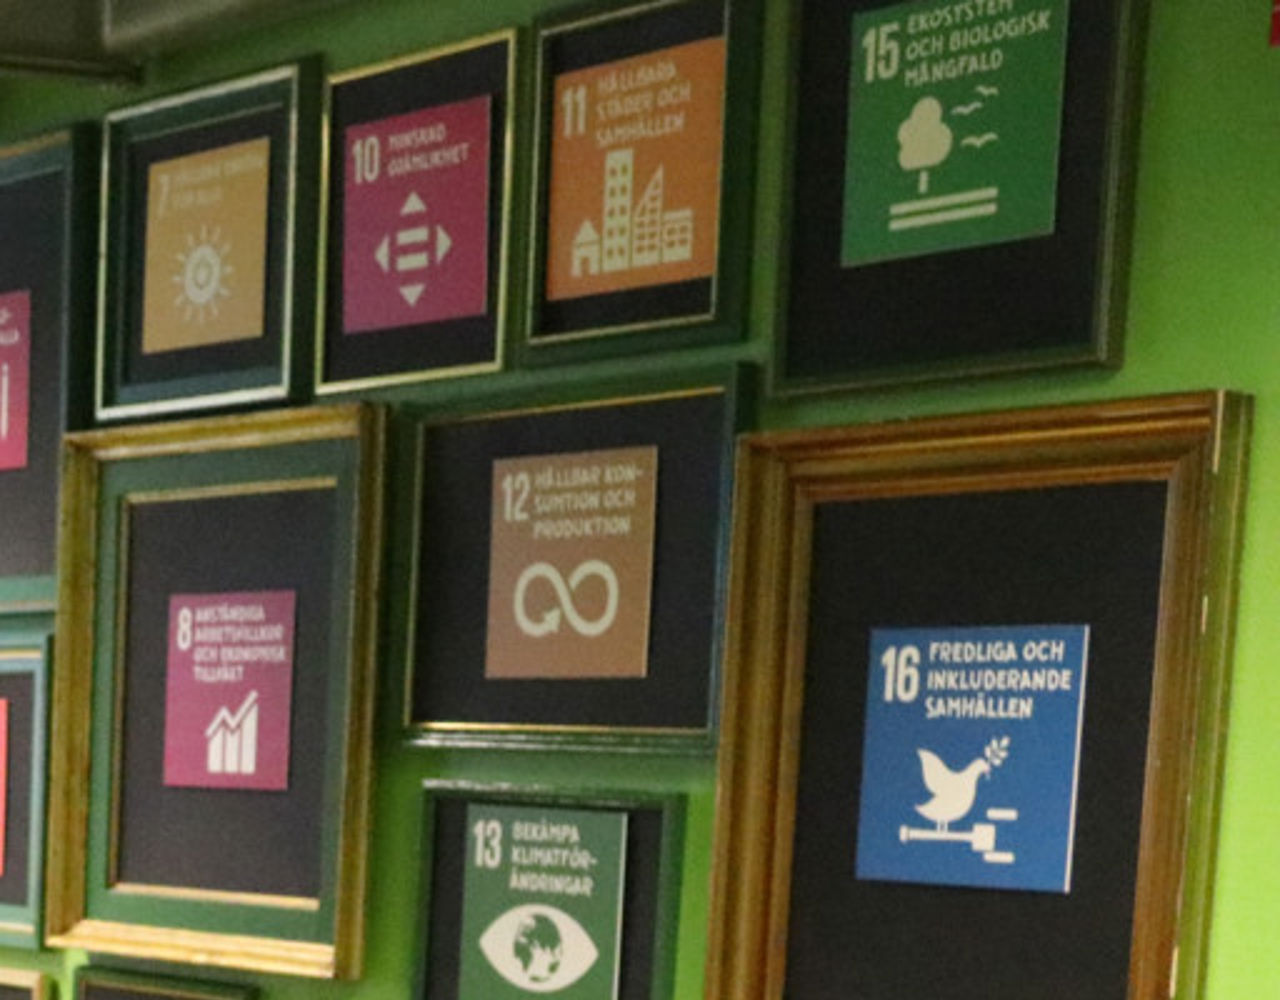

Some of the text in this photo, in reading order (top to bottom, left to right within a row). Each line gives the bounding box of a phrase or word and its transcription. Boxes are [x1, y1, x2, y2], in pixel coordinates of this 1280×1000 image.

[862, 22, 900, 83] 15
[906, 10, 1051, 60] OCH BIOLOGISK
[904, 49, 1003, 86] MÅNGFALD
[562, 84, 587, 140] 11
[353, 136, 380, 183] 10
[502, 472, 530, 522] 12
[603, 488, 636, 508] OCH
[534, 515, 631, 540] PRODUKTION
[178, 606, 192, 651] 8
[929, 639, 1065, 663] FREDLIGA OCH
[881, 646, 920, 703] 16
[927, 668, 1072, 691] INKLUDERANDE
[925, 692, 1034, 719] SAMHÄLLEN
[474, 819, 502, 868] 13
[512, 819, 580, 843] BEKÄMPA
